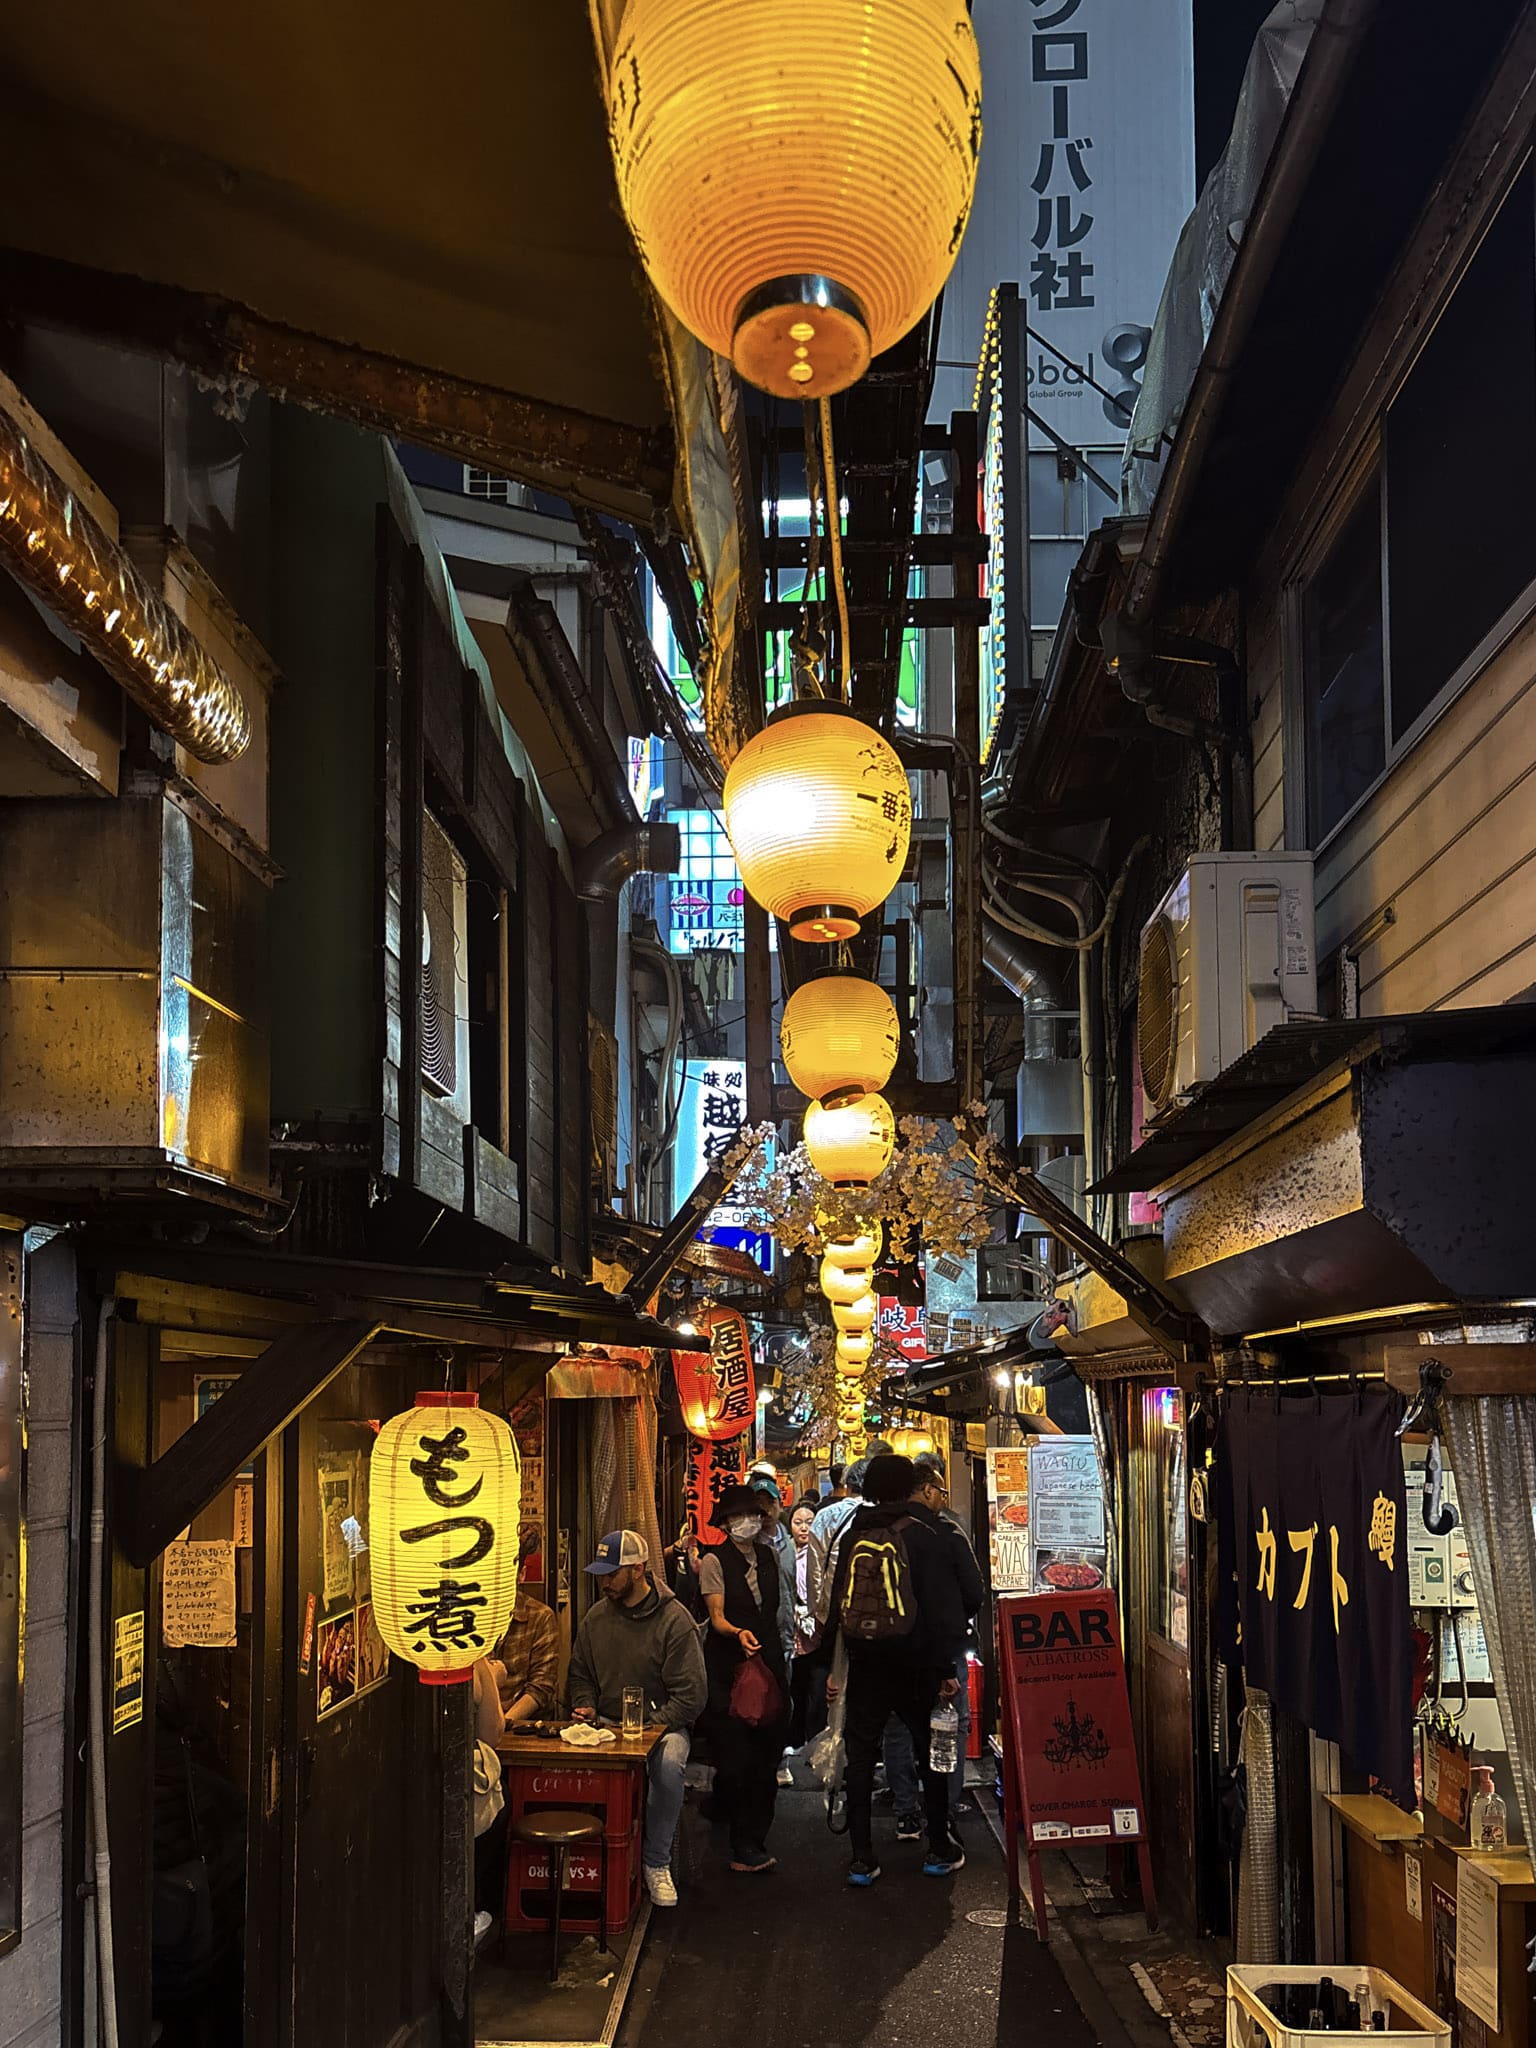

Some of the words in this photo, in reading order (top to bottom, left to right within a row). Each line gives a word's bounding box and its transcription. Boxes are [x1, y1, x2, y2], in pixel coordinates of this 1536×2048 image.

[1029, 390, 1055, 400] Global
[1057, 390, 1083, 398] Group
[711, 1318, 752, 1423] 居酒屋
[399, 1425, 498, 1653] もつ煮
[1012, 1609, 1114, 1650] BAR
[1025, 1649, 1109, 1667] ALBATROSS
[1017, 1674, 1050, 1685] Second
[1052, 1673, 1074, 1682] Floor
[1078, 1669, 1117, 1680] Available
[1030, 1802, 1060, 1812] COVER
[1062, 1799, 1098, 1810] CHARGE
[528, 1865, 585, 1879] SARO
